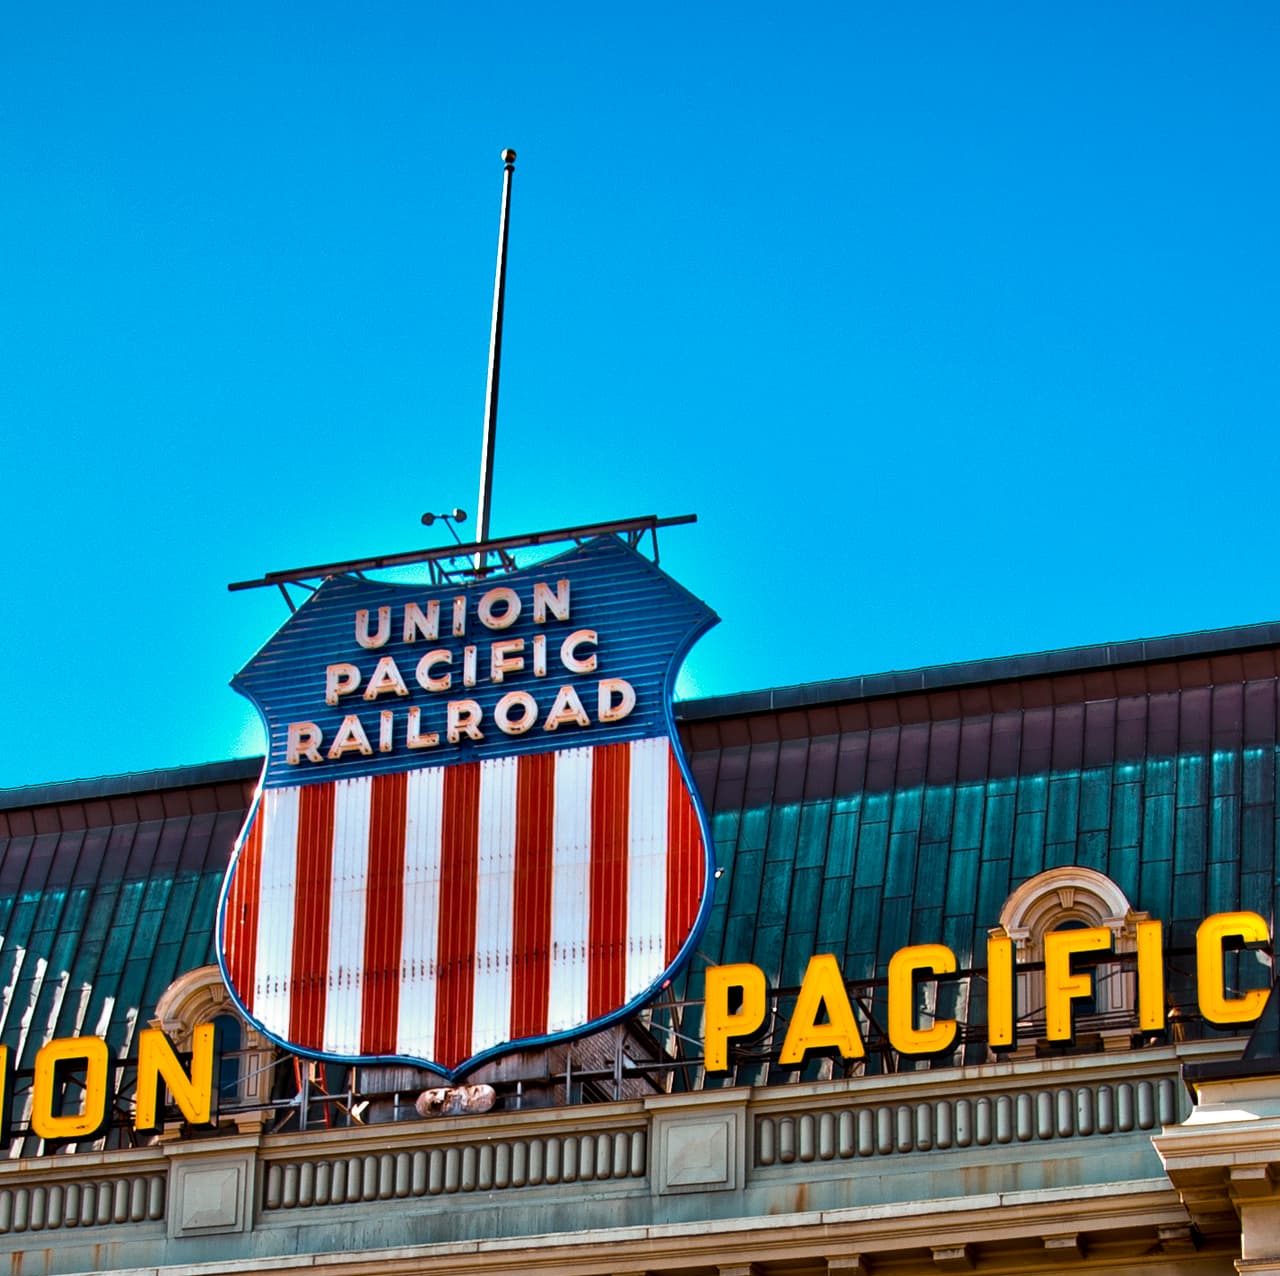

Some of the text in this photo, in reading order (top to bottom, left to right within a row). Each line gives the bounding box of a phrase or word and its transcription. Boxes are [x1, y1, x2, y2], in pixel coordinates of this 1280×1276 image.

[355, 579, 571, 649] UNION
[325, 629, 599, 706] PACIFIC
[286, 678, 637, 766] RAILROAD
[703, 910, 1273, 1073] PACIFIC
